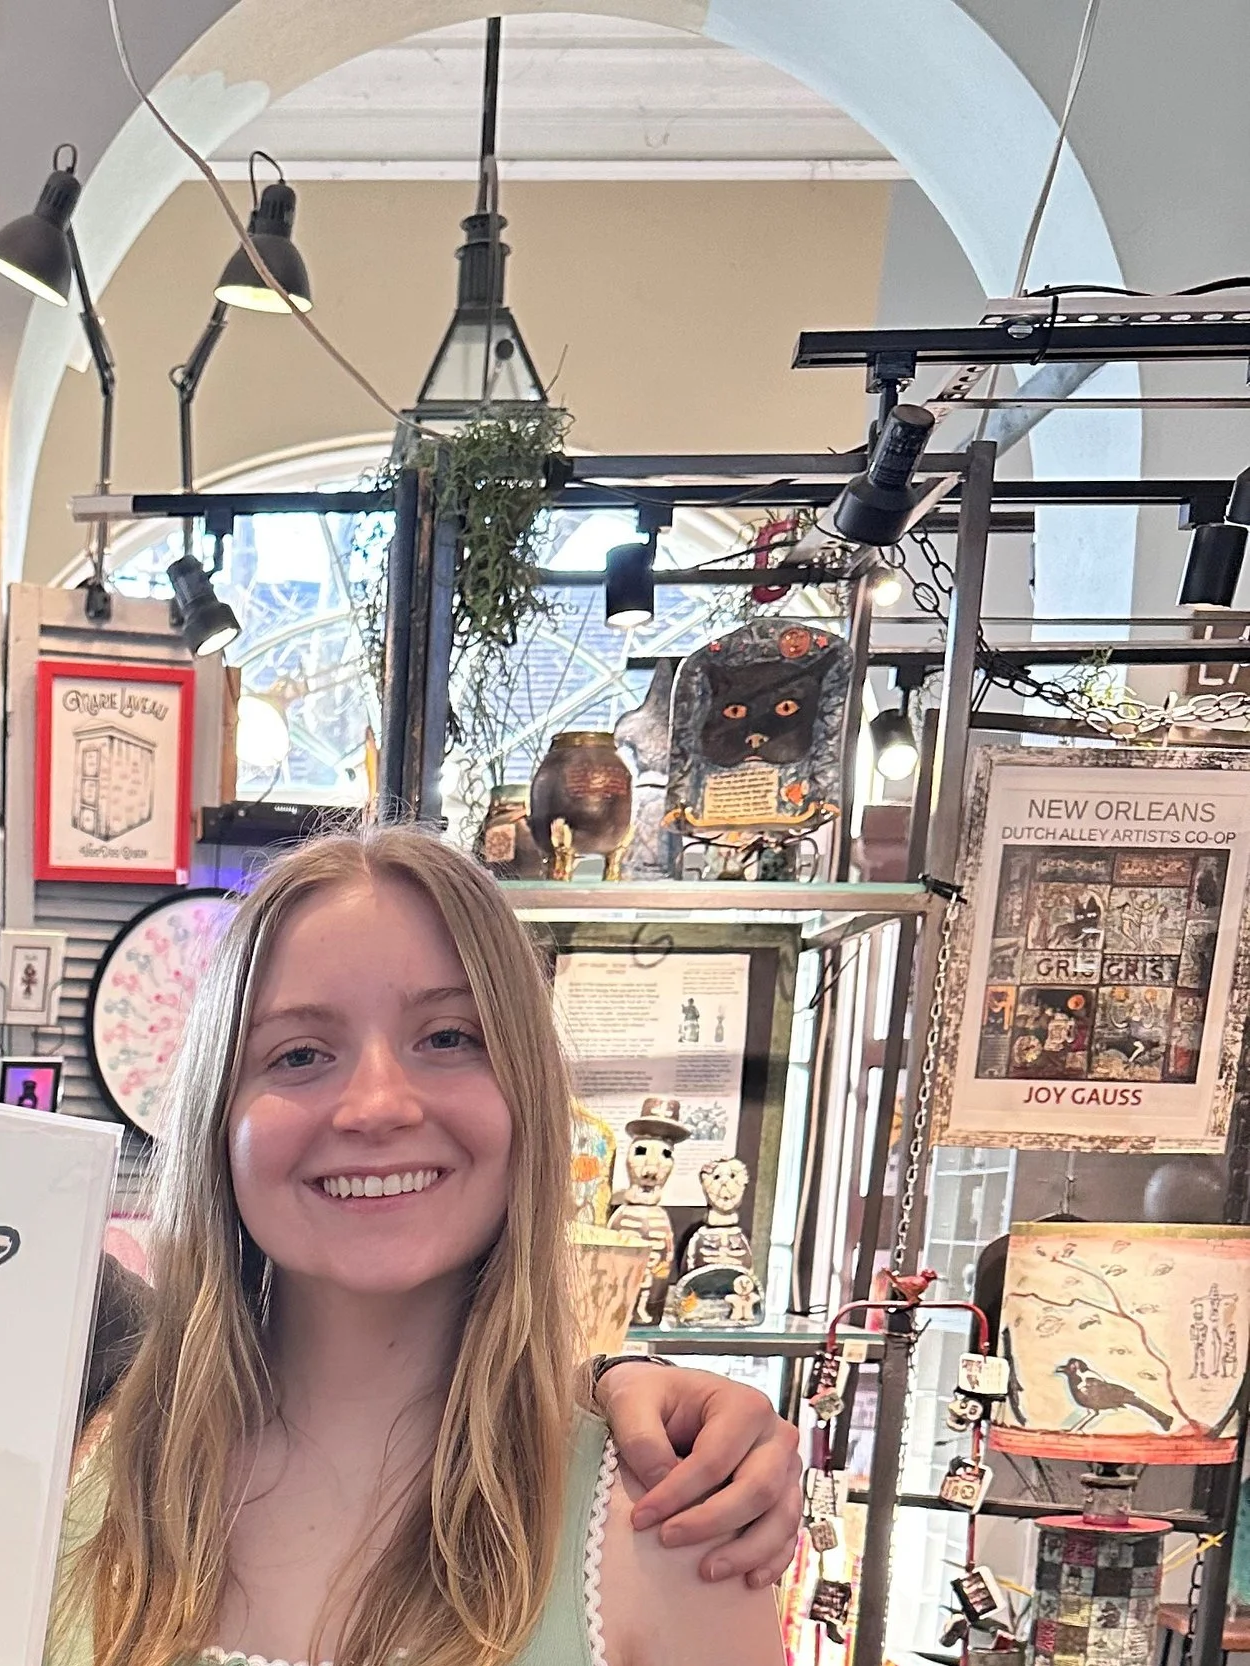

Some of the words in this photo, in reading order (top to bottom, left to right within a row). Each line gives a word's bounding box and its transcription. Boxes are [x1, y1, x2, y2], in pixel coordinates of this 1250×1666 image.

[1028, 799, 1088, 819] NEW
[1095, 800, 1216, 822] ORLEANS
[1002, 826, 1056, 840] DUTCH
[1059, 827, 1109, 841] ALLEY
[1111, 828, 1181, 843] ARTIST'S
[1185, 830, 1236, 844] CO-OP
[1107, 961, 1164, 981] GRIS
[1023, 1086, 1067, 1104] JOY
[1071, 1087, 1143, 1106] GAUSS
